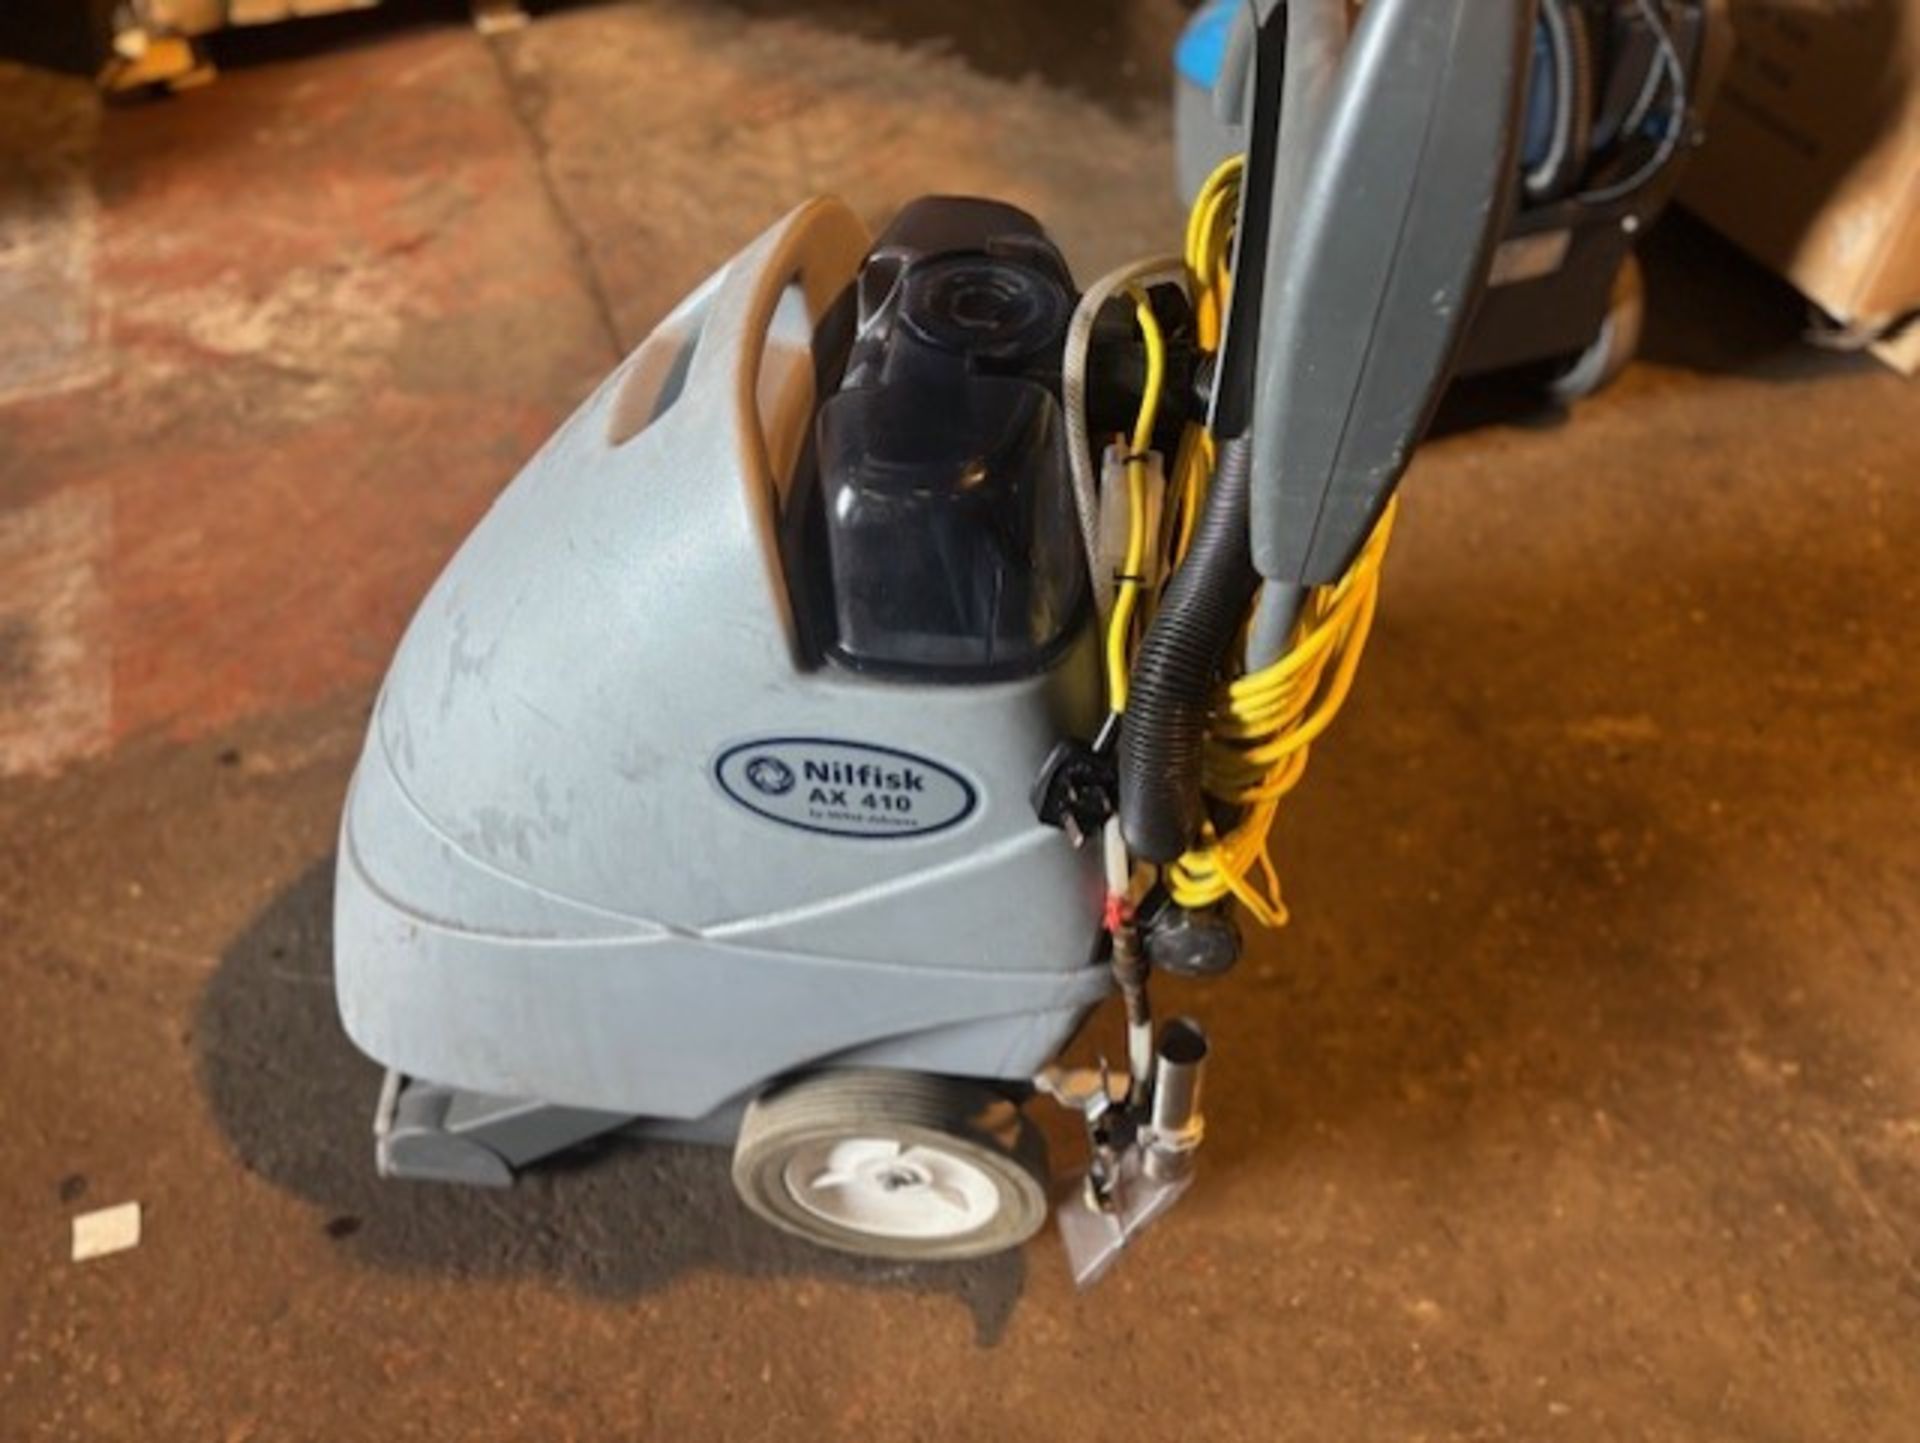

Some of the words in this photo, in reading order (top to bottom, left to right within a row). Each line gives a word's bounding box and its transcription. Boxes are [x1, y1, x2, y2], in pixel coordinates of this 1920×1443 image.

[804, 760, 924, 793] Nilfisk
[809, 787, 847, 807] AX
[861, 793, 912, 812] 410
